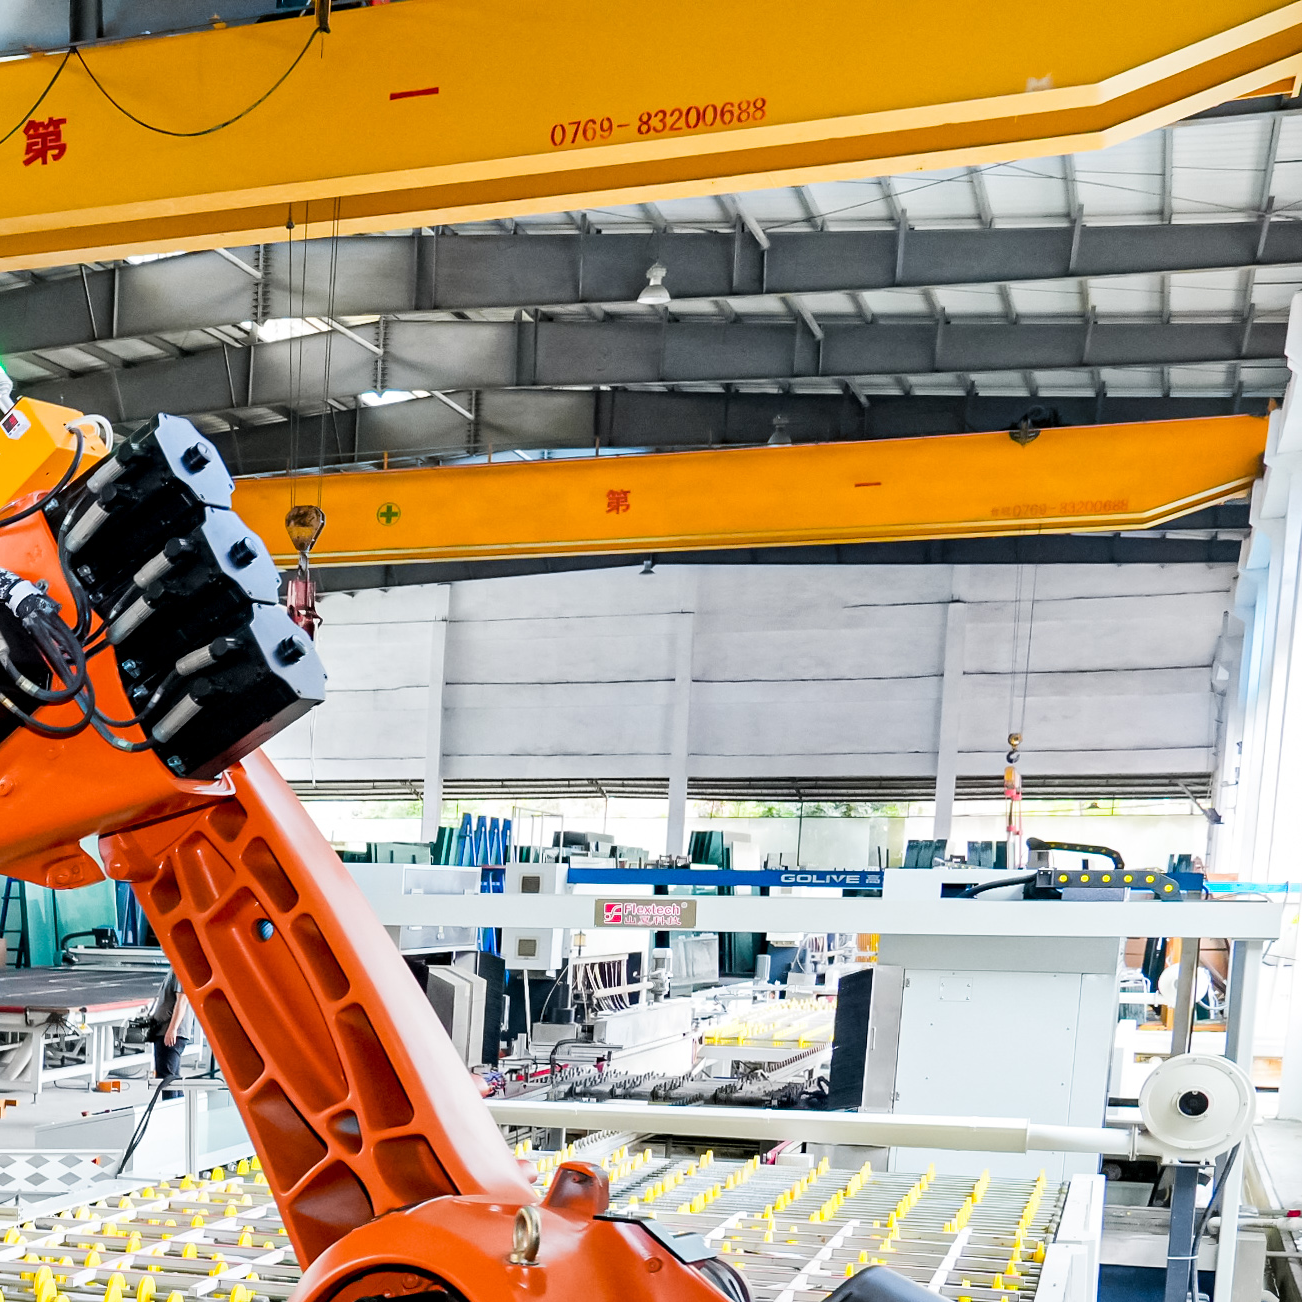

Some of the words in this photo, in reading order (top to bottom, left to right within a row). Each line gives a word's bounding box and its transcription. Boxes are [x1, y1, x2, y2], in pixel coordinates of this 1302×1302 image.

[550, 97, 767, 147] 0769-83200688
[23, 117, 66, 166] 第
[606, 489, 631, 514] 第
[780, 874, 860, 884] GOLIVE
[623, 902, 681, 916] Flextech
